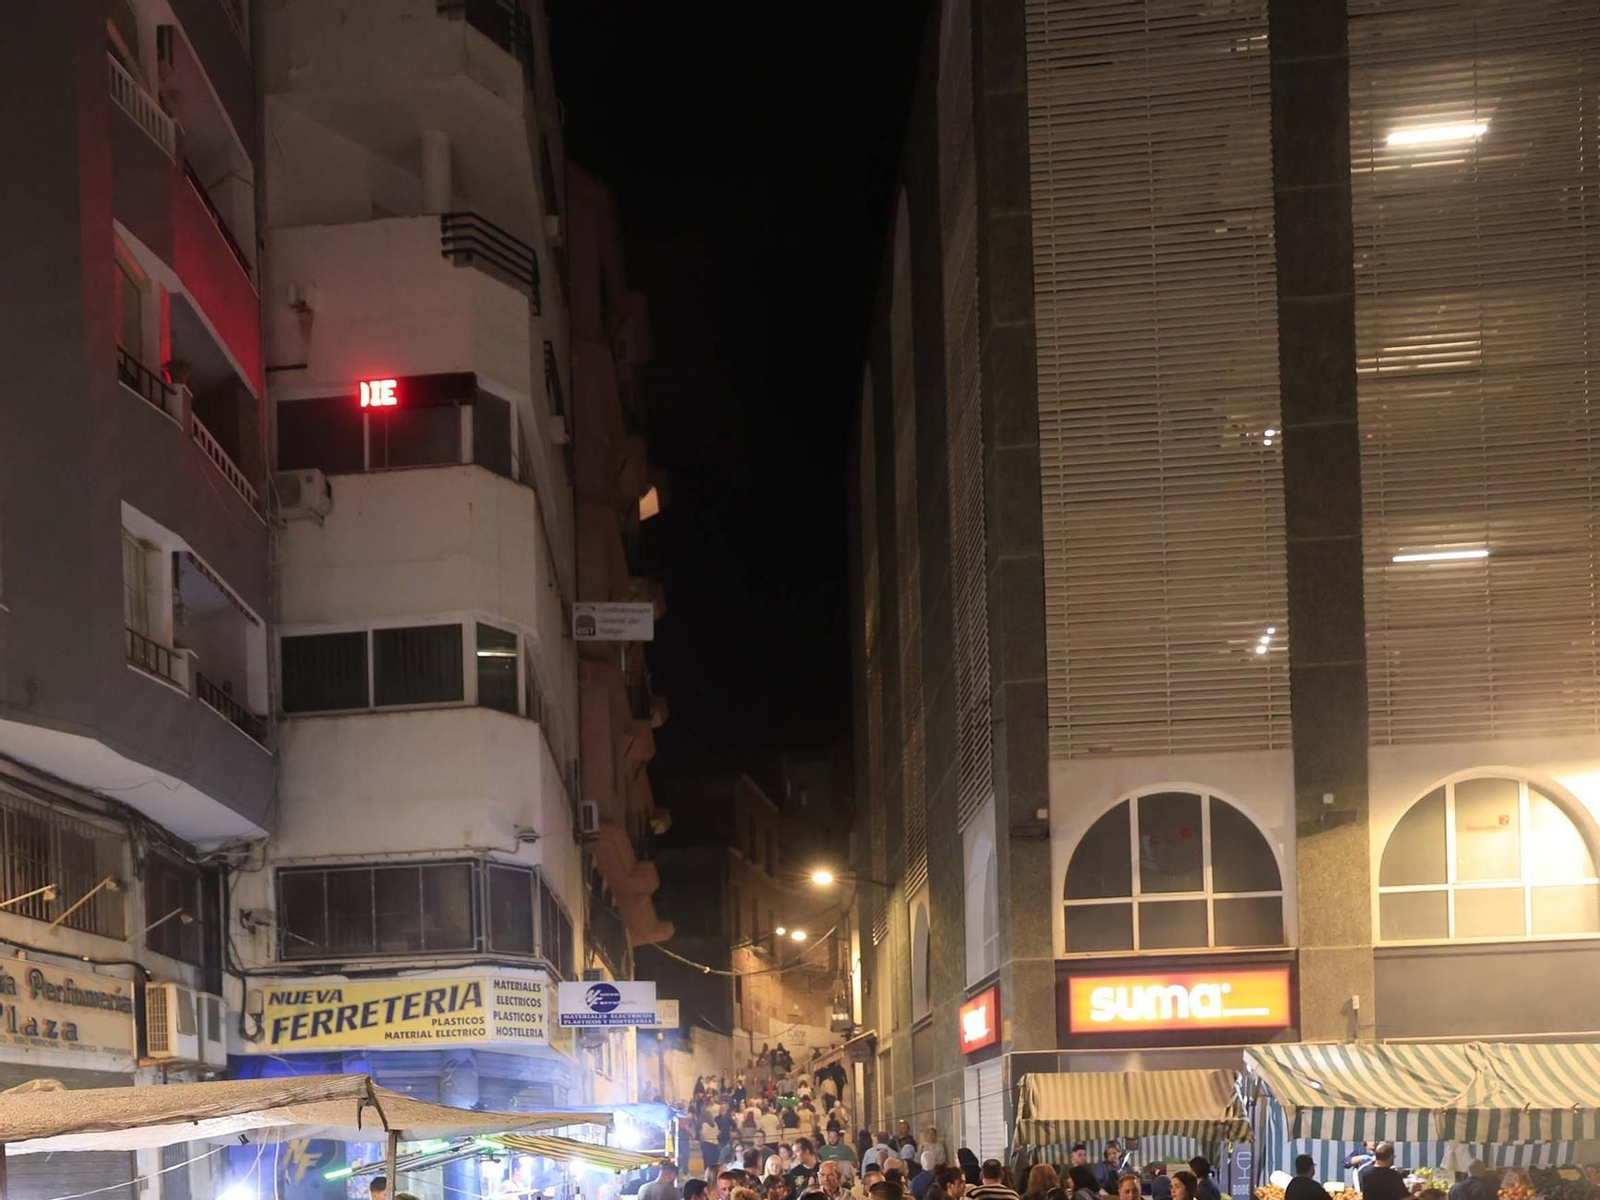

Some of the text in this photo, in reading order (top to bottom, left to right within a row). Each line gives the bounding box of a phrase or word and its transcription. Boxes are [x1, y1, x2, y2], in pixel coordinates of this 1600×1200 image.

[493, 979, 541, 993] MATERIALES
[269, 988, 344, 1006] NUEVA
[496, 994, 542, 1008] ELECTRICOS
[1090, 982, 1223, 1022] suma
[271, 980, 483, 1046] FERRETERIA
[492, 1010, 543, 1023] PLASTICOS Y
[0, 1003, 79, 1041] laza
[431, 1016, 485, 1027] PLASTICOS
[384, 1027, 487, 1041] MATERIAL ELECTRICO
[496, 1025, 544, 1038] HOSTELERIA
